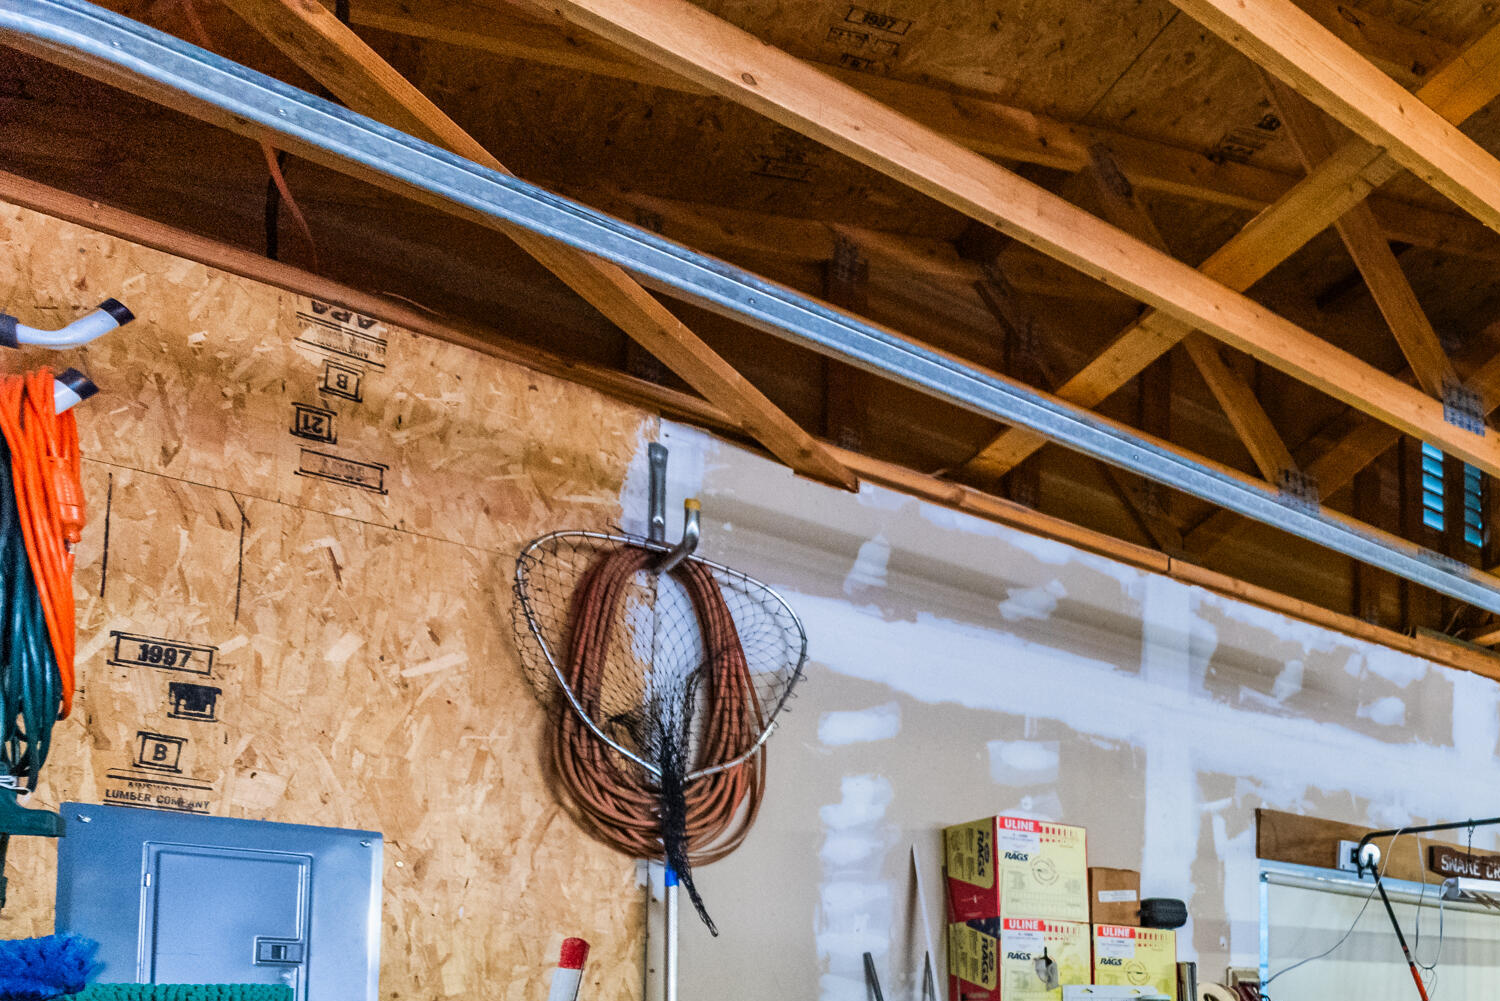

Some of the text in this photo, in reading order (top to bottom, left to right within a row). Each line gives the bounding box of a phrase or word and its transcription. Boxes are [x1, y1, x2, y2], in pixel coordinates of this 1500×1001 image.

[336, 373, 348, 391] B
[302, 413, 325, 435] 21
[137, 643, 193, 669] 1997
[152, 743, 168, 762] B
[105, 788, 152, 803] LUMBER
[1004, 818, 1034, 831] ULINE
[977, 830, 985, 877] RAGS
[1005, 851, 1029, 861] RAGS
[1441, 854, 1481, 876] SNAKE
[1008, 919, 1039, 930] ULINE
[1102, 927, 1130, 937] ULINE
[981, 937, 989, 984] RAGS
[1007, 951, 1032, 960] RAGS
[1100, 957, 1123, 966] RAGS
